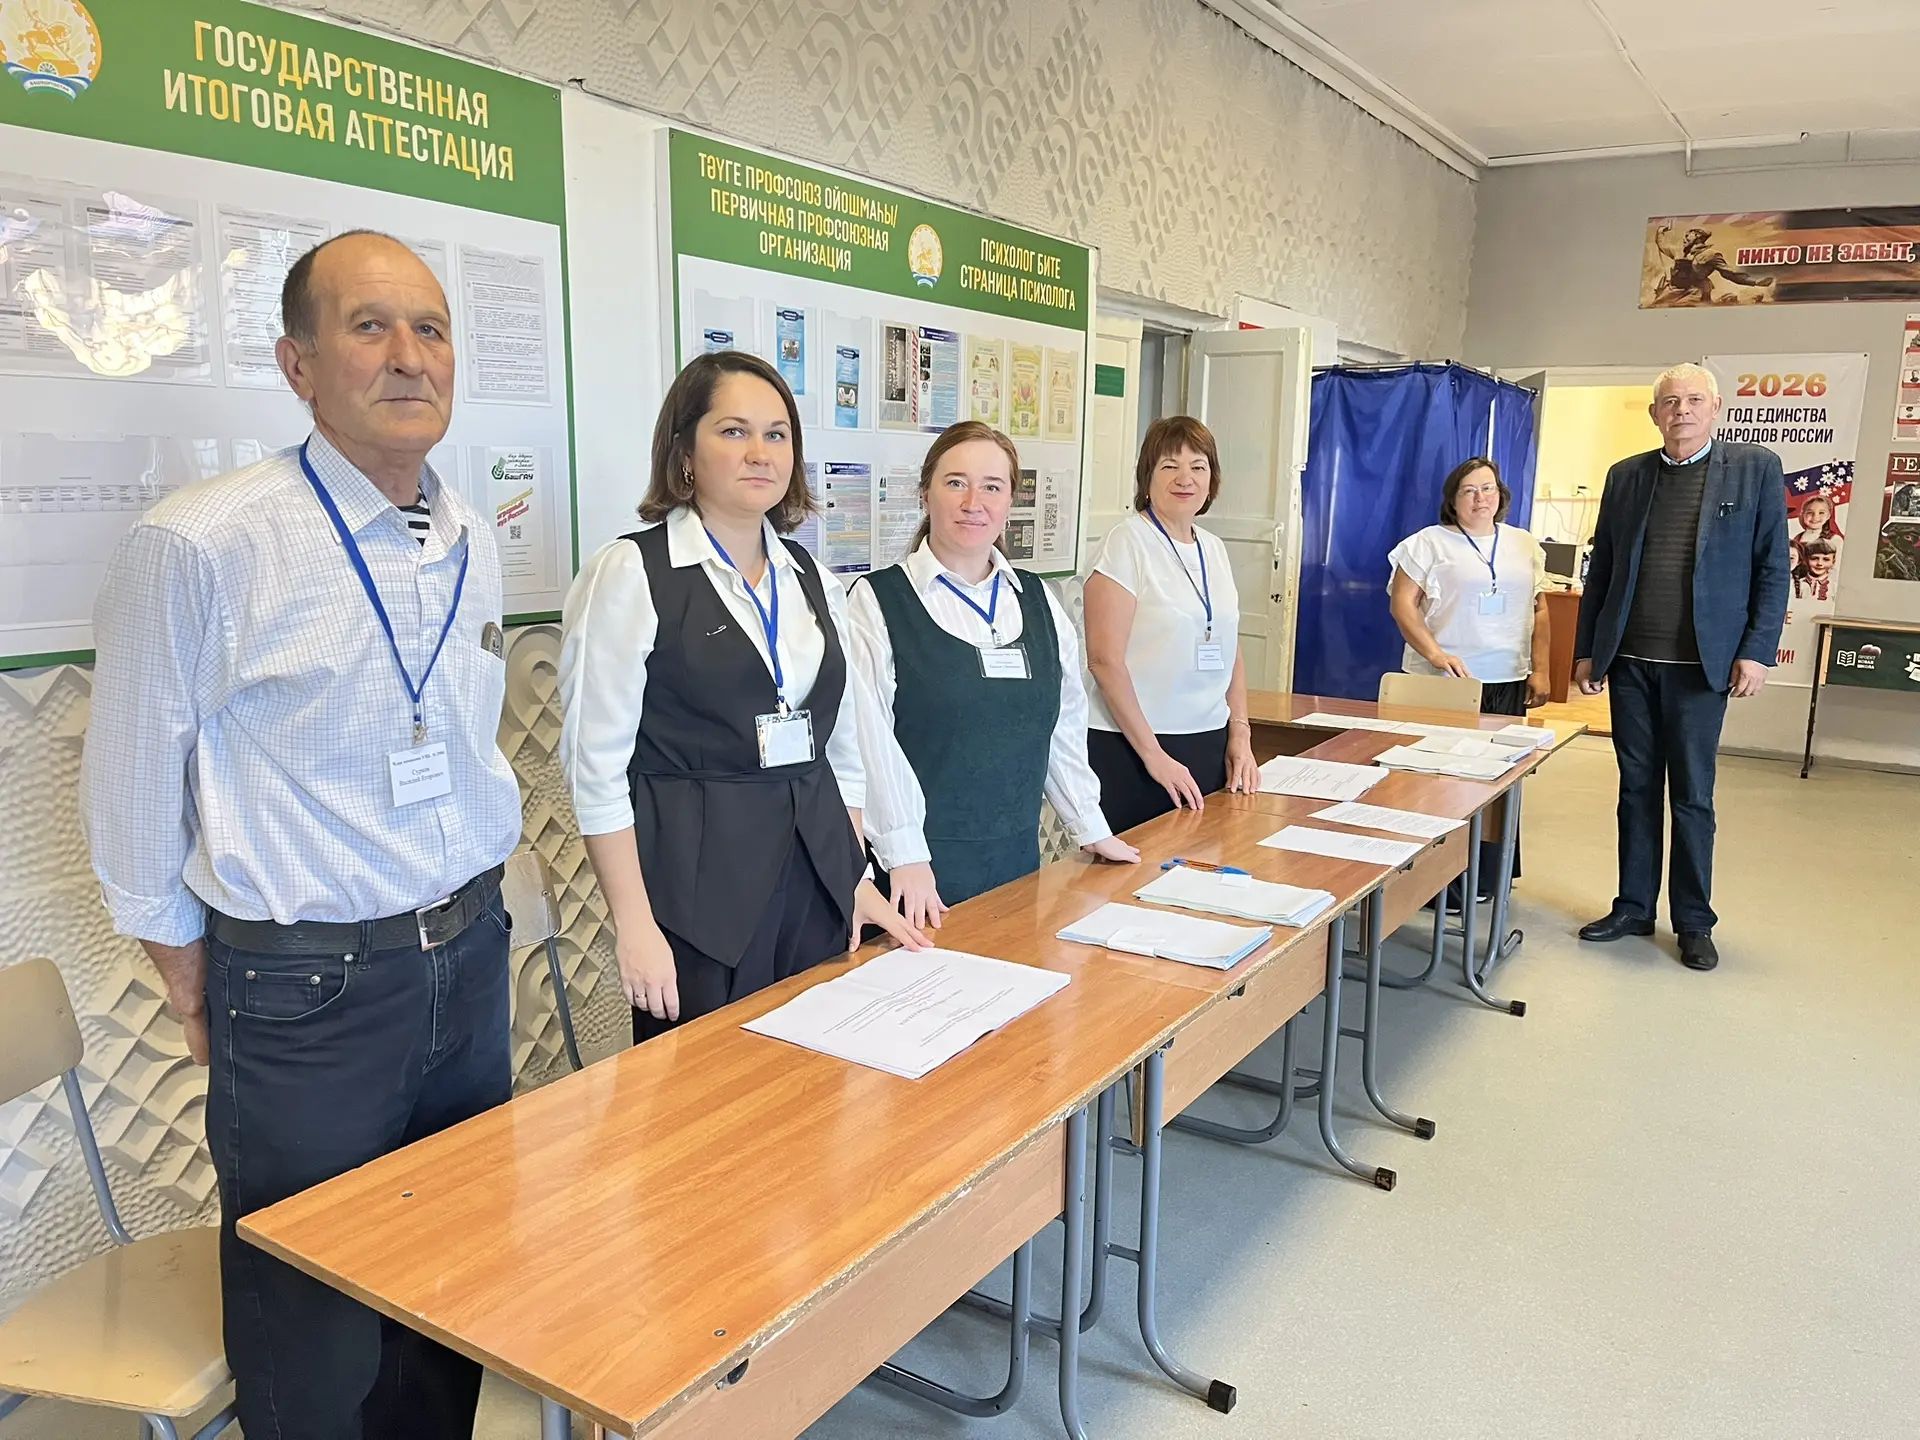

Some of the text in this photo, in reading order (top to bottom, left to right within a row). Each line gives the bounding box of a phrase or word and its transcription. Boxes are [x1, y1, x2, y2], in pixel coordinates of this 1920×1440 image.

[194, 20, 489, 129] ГОСУДАРСТВЕННАЯ
[163, 69, 514, 182] ИТОГОВАЯ АТТЕСТАЦИЯ
[745, 165, 822, 207] ПРОФСОЮЗ
[711, 188, 889, 252] ПЕРВИЧНАЯ ПРОФСОЮЗНАЯ
[759, 231, 852, 272] ОРГАНИЗАЦИЯ
[980, 238, 1062, 280] ПСИХОЛОГ БИТЕ
[1737, 242, 1915, 266] НИКТО НЕ ЗАБЫТ,
[960, 264, 1076, 311] СТРАНИЦА ПСИХОЛОГА
[1736, 373, 1827, 397] 2026
[1716, 428, 1834, 443] НАРОДОВ РОССИИ
[1727, 407, 1827, 423] ГОД ЕДИНСТВА
